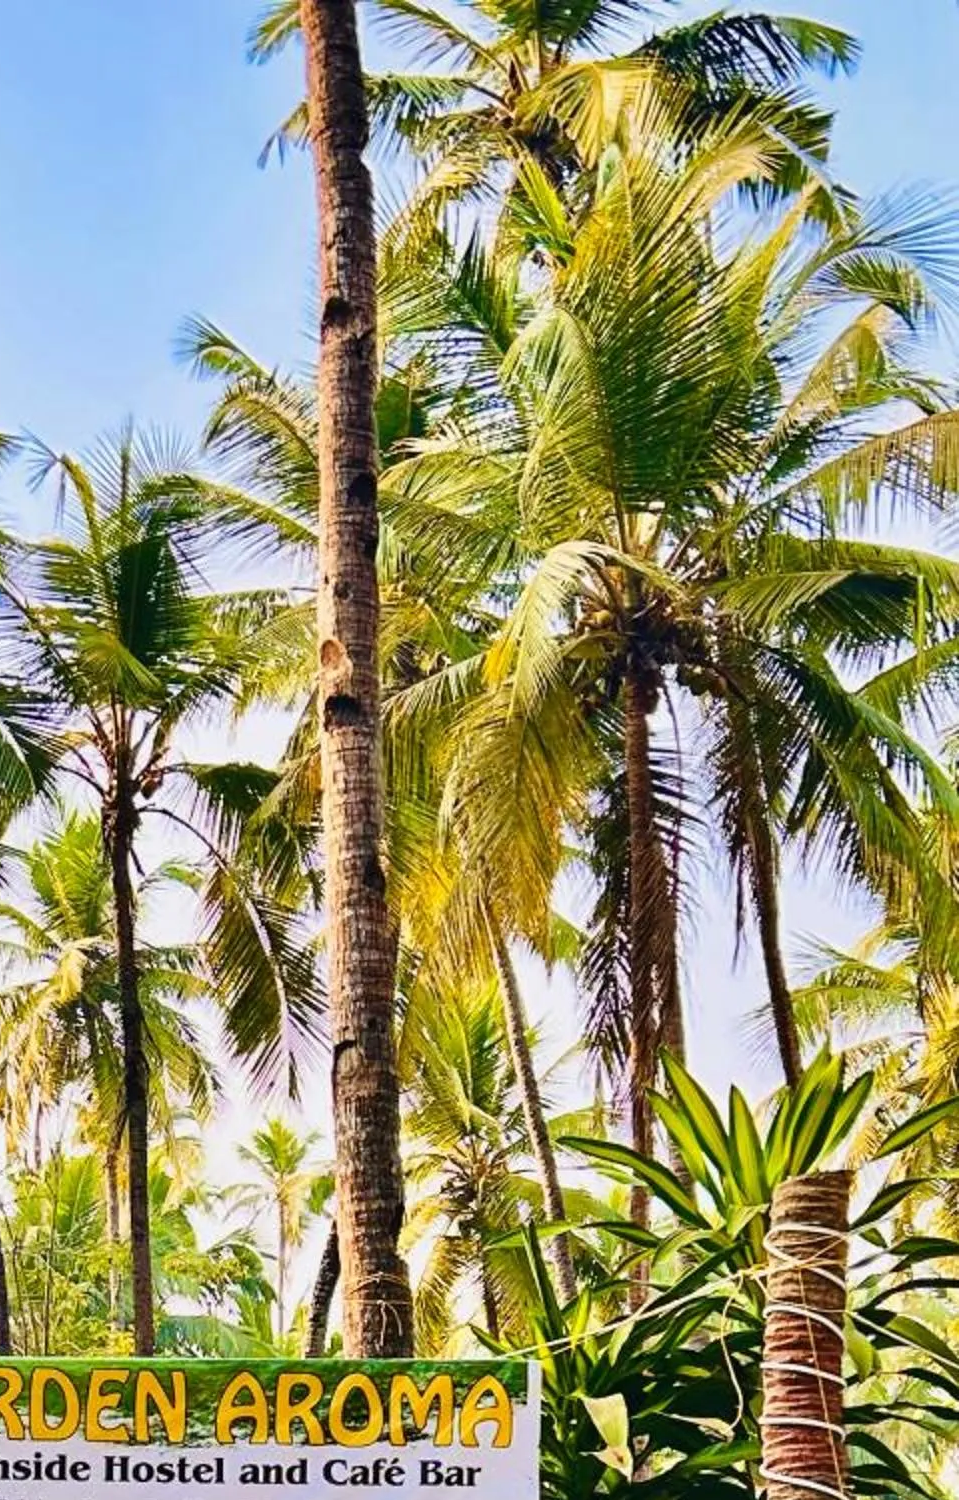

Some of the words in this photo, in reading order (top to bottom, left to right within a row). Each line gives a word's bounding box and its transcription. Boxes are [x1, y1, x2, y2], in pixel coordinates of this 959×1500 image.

[215, 1370, 515, 1449] AROMA
[104, 1455, 225, 1485] Hostel
[240, 1458, 308, 1486] and
[322, 1457, 405, 1488] Café
[419, 1459, 482, 1488] Bar
